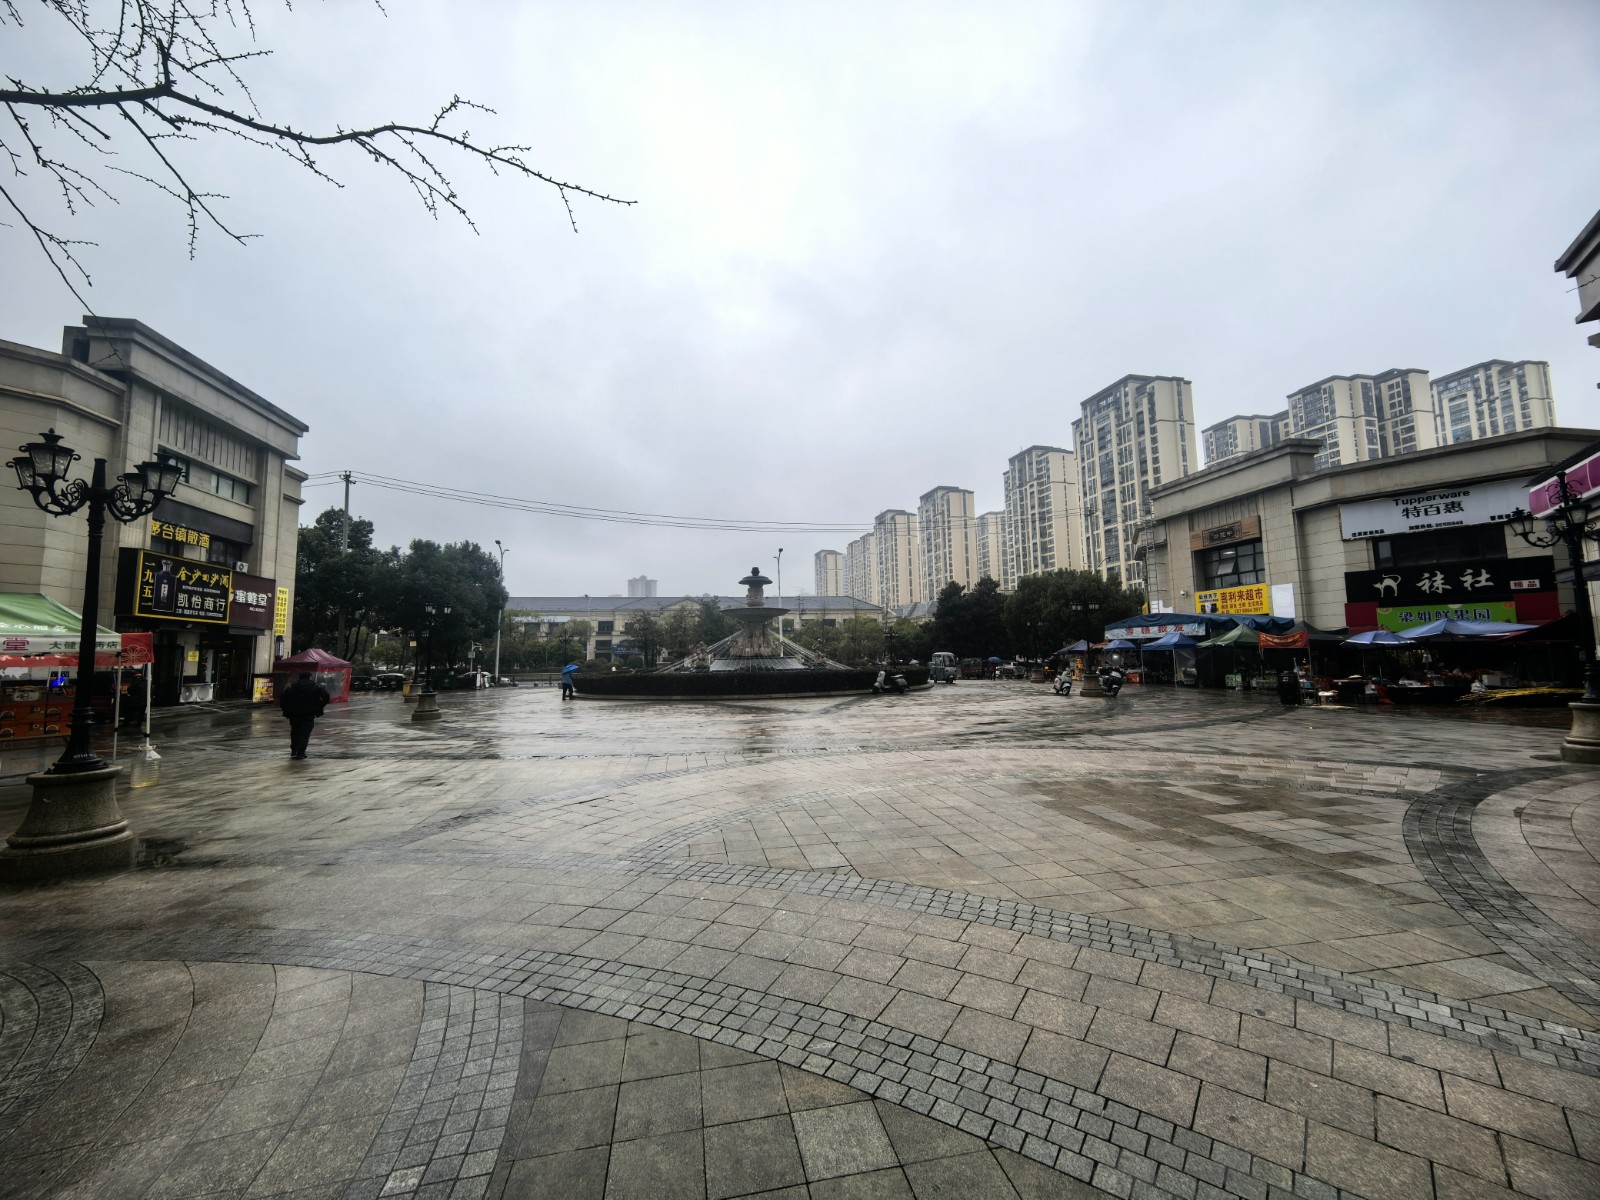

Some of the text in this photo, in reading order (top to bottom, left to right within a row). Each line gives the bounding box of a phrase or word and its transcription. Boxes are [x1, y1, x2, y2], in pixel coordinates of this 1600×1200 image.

[1392, 489, 1471, 506] Tupperware
[1401, 501, 1465, 519] 特百惠
[150, 520, 210, 548] 茅台镇散酒
[140, 561, 156, 606] 一九五一
[1416, 568, 1495, 594] 袜社
[177, 592, 226, 612] 凯怡商行
[235, 590, 268, 607] 蜜蜂堂
[1220, 588, 1263, 604] 喜利来超市
[1398, 608, 1491, 623] 梁姐鲜果园
[2, 637, 29, 651] 堂
[49, 640, 119, 650] 大健药店
